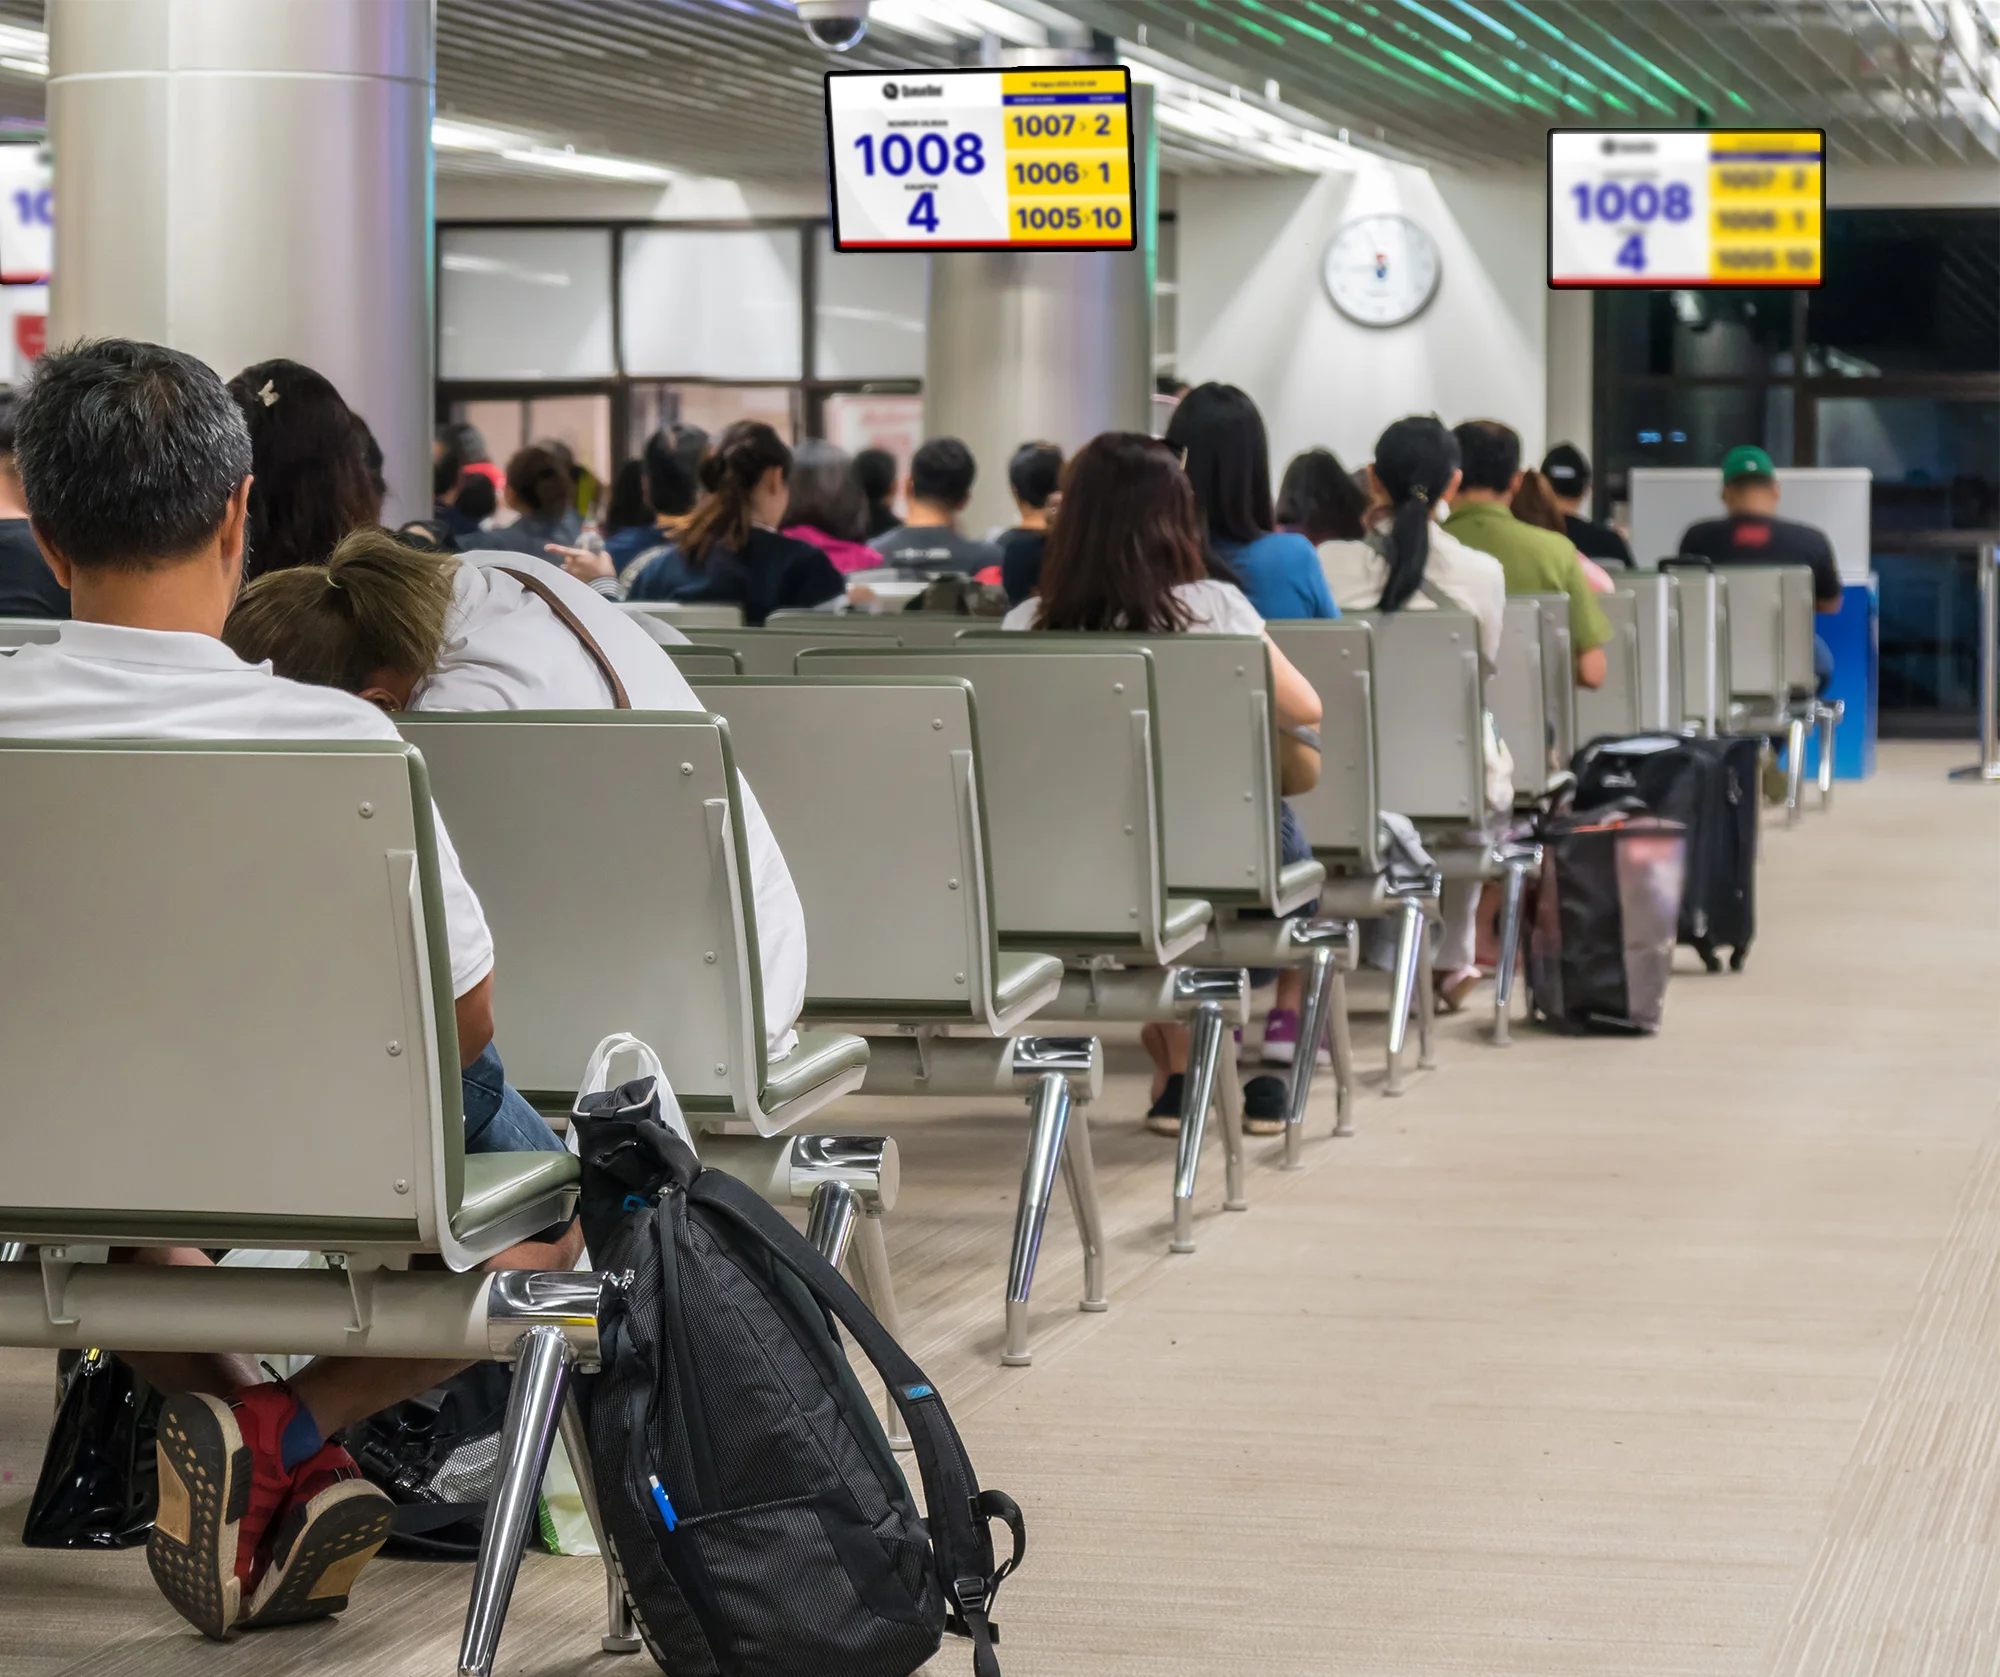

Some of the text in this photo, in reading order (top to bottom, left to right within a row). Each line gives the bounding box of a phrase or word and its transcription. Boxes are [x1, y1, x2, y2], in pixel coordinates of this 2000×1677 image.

[1012, 114, 1111, 137] 1007 2
[854, 132, 985, 176] 1008
[1014, 162, 1110, 184] 1006 1
[907, 191, 939, 233] 4
[1017, 207, 1122, 230] 1005 10
[1572, 181, 1692, 223] 1008
[1616, 233, 1647, 272] 4
